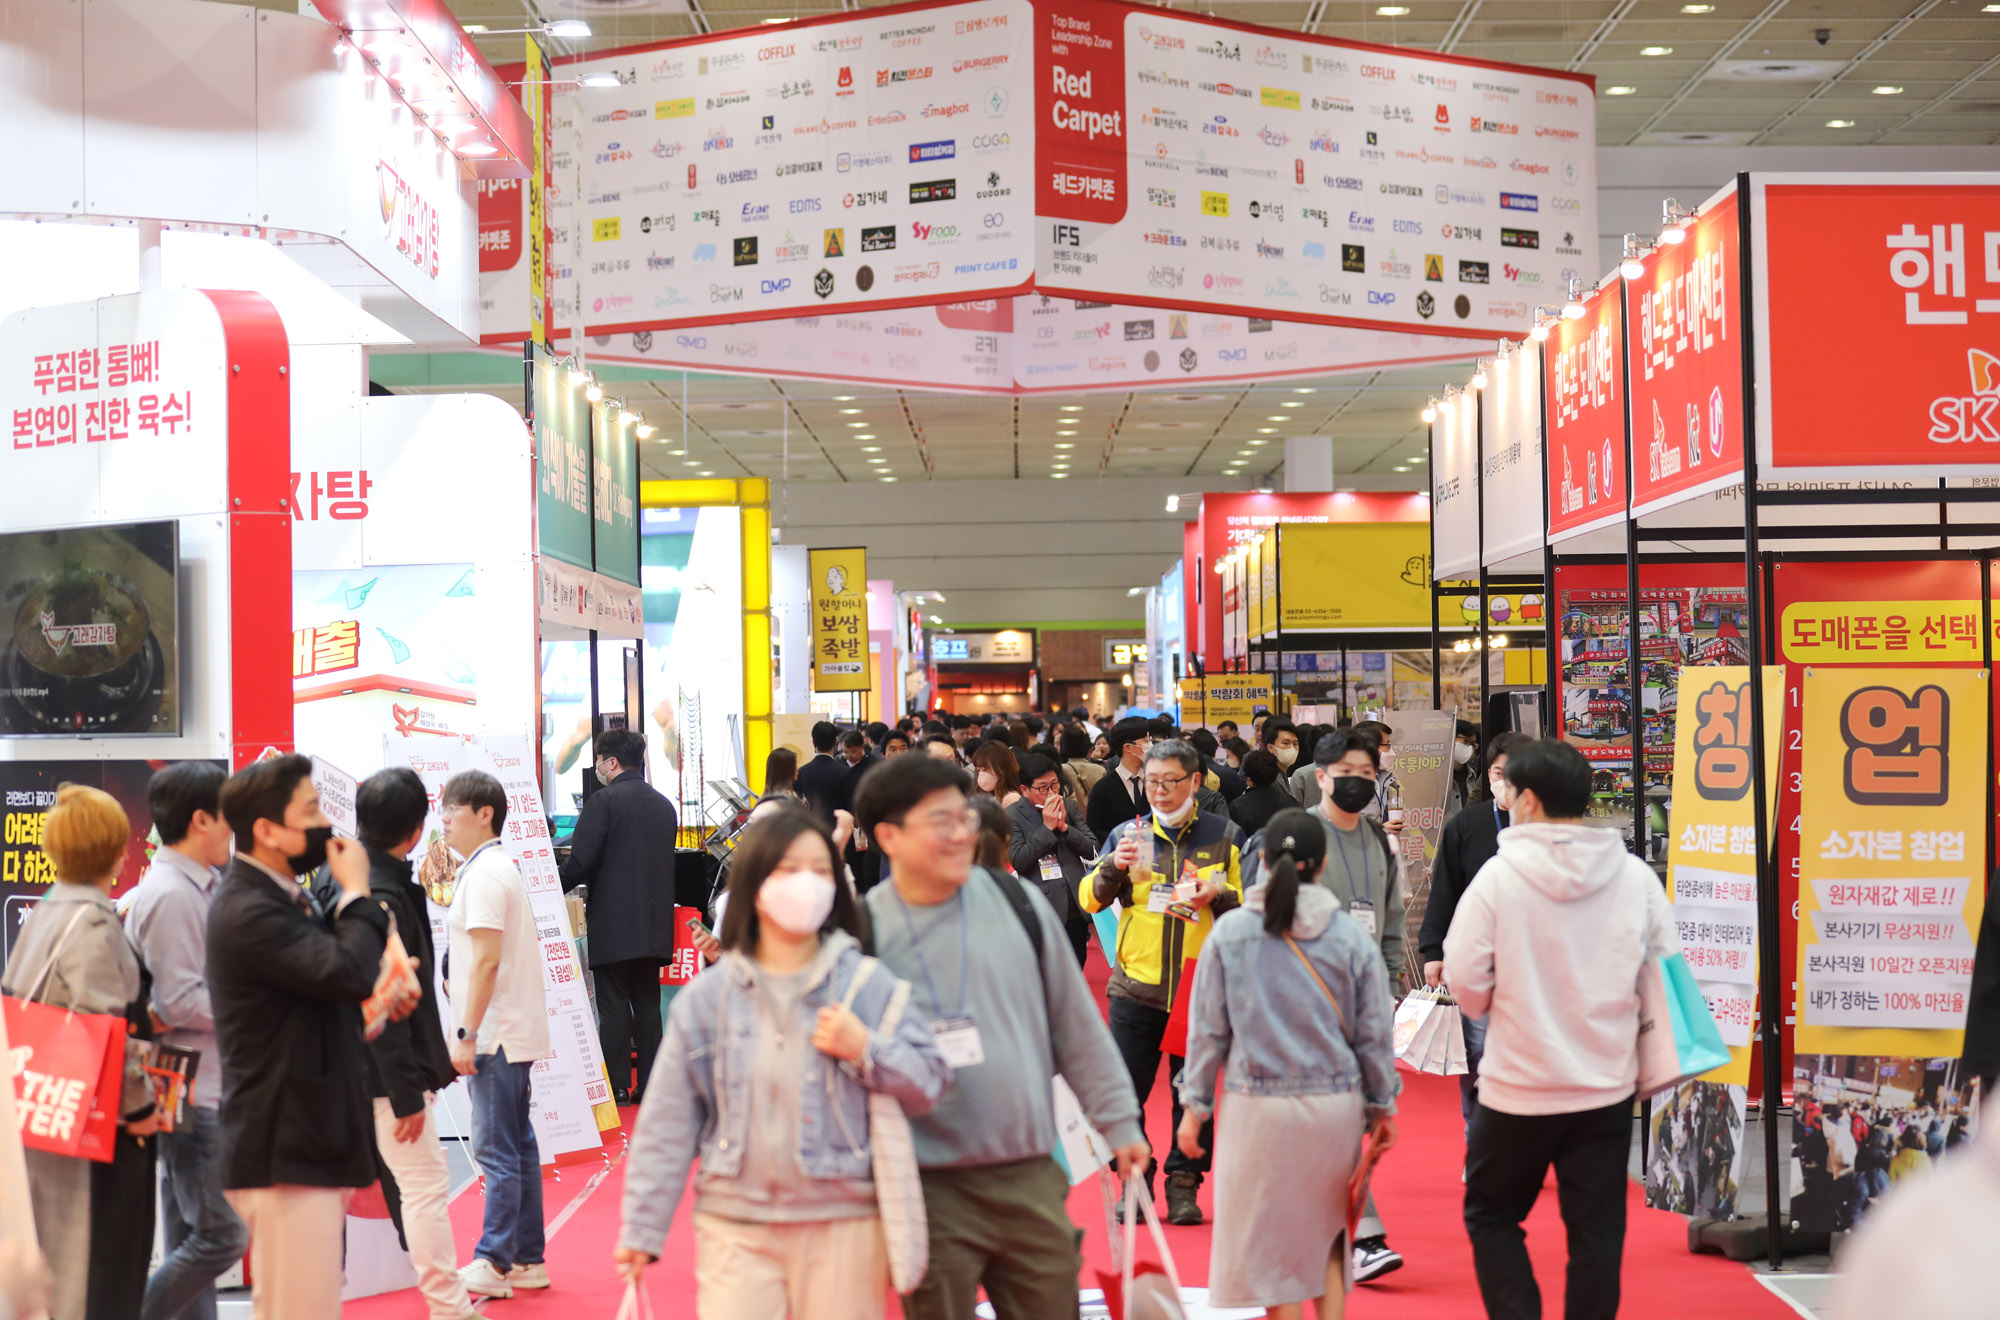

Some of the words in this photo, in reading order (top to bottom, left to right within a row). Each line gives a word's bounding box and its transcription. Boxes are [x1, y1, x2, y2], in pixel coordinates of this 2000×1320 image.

[880, 29, 905, 40] BETTER
[906, 26, 936, 38] MONDAY
[1052, 15, 1067, 30] Top
[1068, 18, 1091, 32] Brand
[892, 37, 922, 48] COFFEE
[1052, 30, 1093, 47] Leadership
[1094, 36, 1113, 49] Zone
[758, 44, 796, 61] COFFLIX
[1052, 43, 1069, 56] with
[963, 55, 1010, 68] BURGERRY
[891, 67, 933, 82] 치킨몬스터
[1052, 65, 1092, 98] Red
[1360, 65, 1396, 80] COFFLIX
[1052, 100, 1122, 140] Carpet
[1053, 173, 1115, 201] 레드카펫존
[789, 198, 821, 213] EDMS
[857, 190, 888, 206] 김가네
[742, 203, 769, 215] Erae
[1349, 211, 1375, 224] Erae
[1053, 224, 1080, 246] IFS
[1454, 226, 1482, 240] 김가네
[954, 264, 981, 274] PRINT
[984, 262, 1007, 272] CAFE
[1641, 279, 1674, 381] 핸드폰
[1675, 241, 1726, 354] 도매센터
[34, 348, 100, 395] 푸짐한
[108, 340, 159, 388] 통뼈!
[1554, 344, 1579, 429] 핸드폰
[1579, 317, 1614, 410] 도매센터
[13, 403, 77, 450] 본연의
[86, 397, 130, 443] 진한
[138, 391, 191, 437] 육수!
[1928, 396, 2000, 443] SK
[819, 599, 861, 612] 원할머니
[821, 615, 860, 634] 보쌈
[1790, 615, 1911, 650] 도매폰을
[1919, 614, 1977, 650] 선택
[73, 625, 115, 644] 고래감자탕
[821, 637, 860, 659] 족발
[1210, 688, 1243, 700] 박람회
[1246, 687, 1268, 700] 혜택
[1789, 730, 1802, 750] 2
[1839, 684, 1951, 807] 업
[1789, 772, 1802, 792] 3
[6, 791, 35, 806] 라면보다
[1680, 824, 1727, 854] 소자본
[1820, 830, 1903, 861] 소자본
[1910, 831, 1965, 861] 창업
[3, 851, 21, 882] 다
[1828, 885, 1899, 907] 원자재값
[1715, 923, 1744, 944] 인테리어
[1824, 922, 1880, 939] 본사기기
[1884, 923, 1955, 941] 무상지원!!
[1706, 948, 1723, 966] 50%
[1725, 950, 1748, 970] 저렴!!
[1808, 956, 1864, 973] 본사직원
[1869, 957, 1914, 973] 10일간
[1918, 957, 1974, 975] 오픈지원
[1810, 990, 1837, 1010] 내가
[1840, 990, 1880, 1011] 정하는
[1884, 992, 1921, 1010] 100%
[1925, 992, 1965, 1013] 마진율
[24, 1070, 85, 1111] THE
